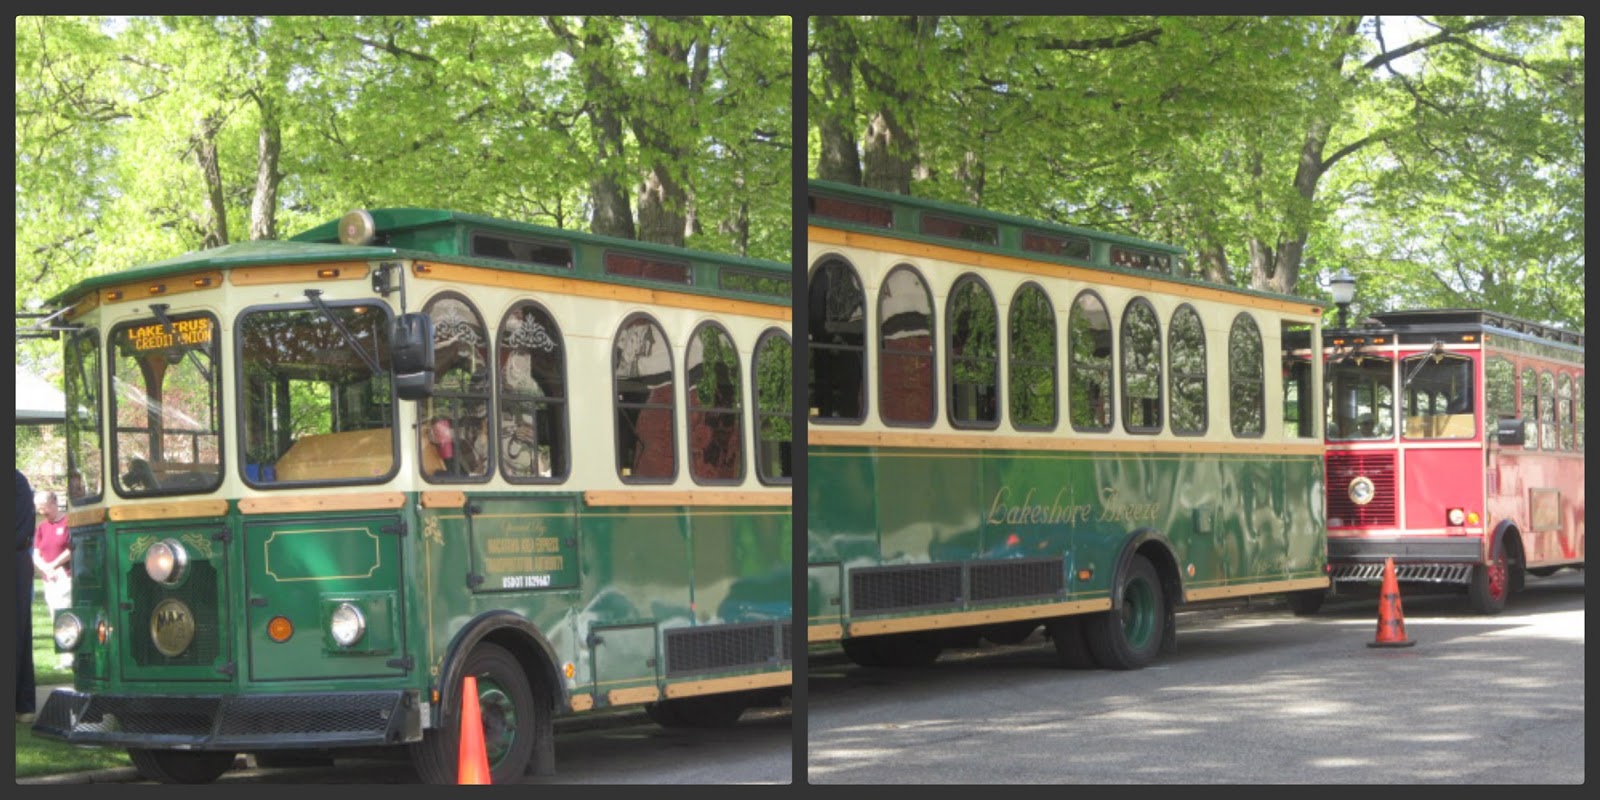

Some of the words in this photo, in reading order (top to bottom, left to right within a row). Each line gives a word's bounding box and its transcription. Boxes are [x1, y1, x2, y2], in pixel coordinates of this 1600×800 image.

[128, 324, 164, 340] LAKE
[171, 317, 212, 334] TRUS
[136, 333, 173, 351] CREDIT
[986, 486, 1092, 525] Lakeshore
[1097, 487, 1161, 523] Breeze
[157, 610, 184, 627] MAX
